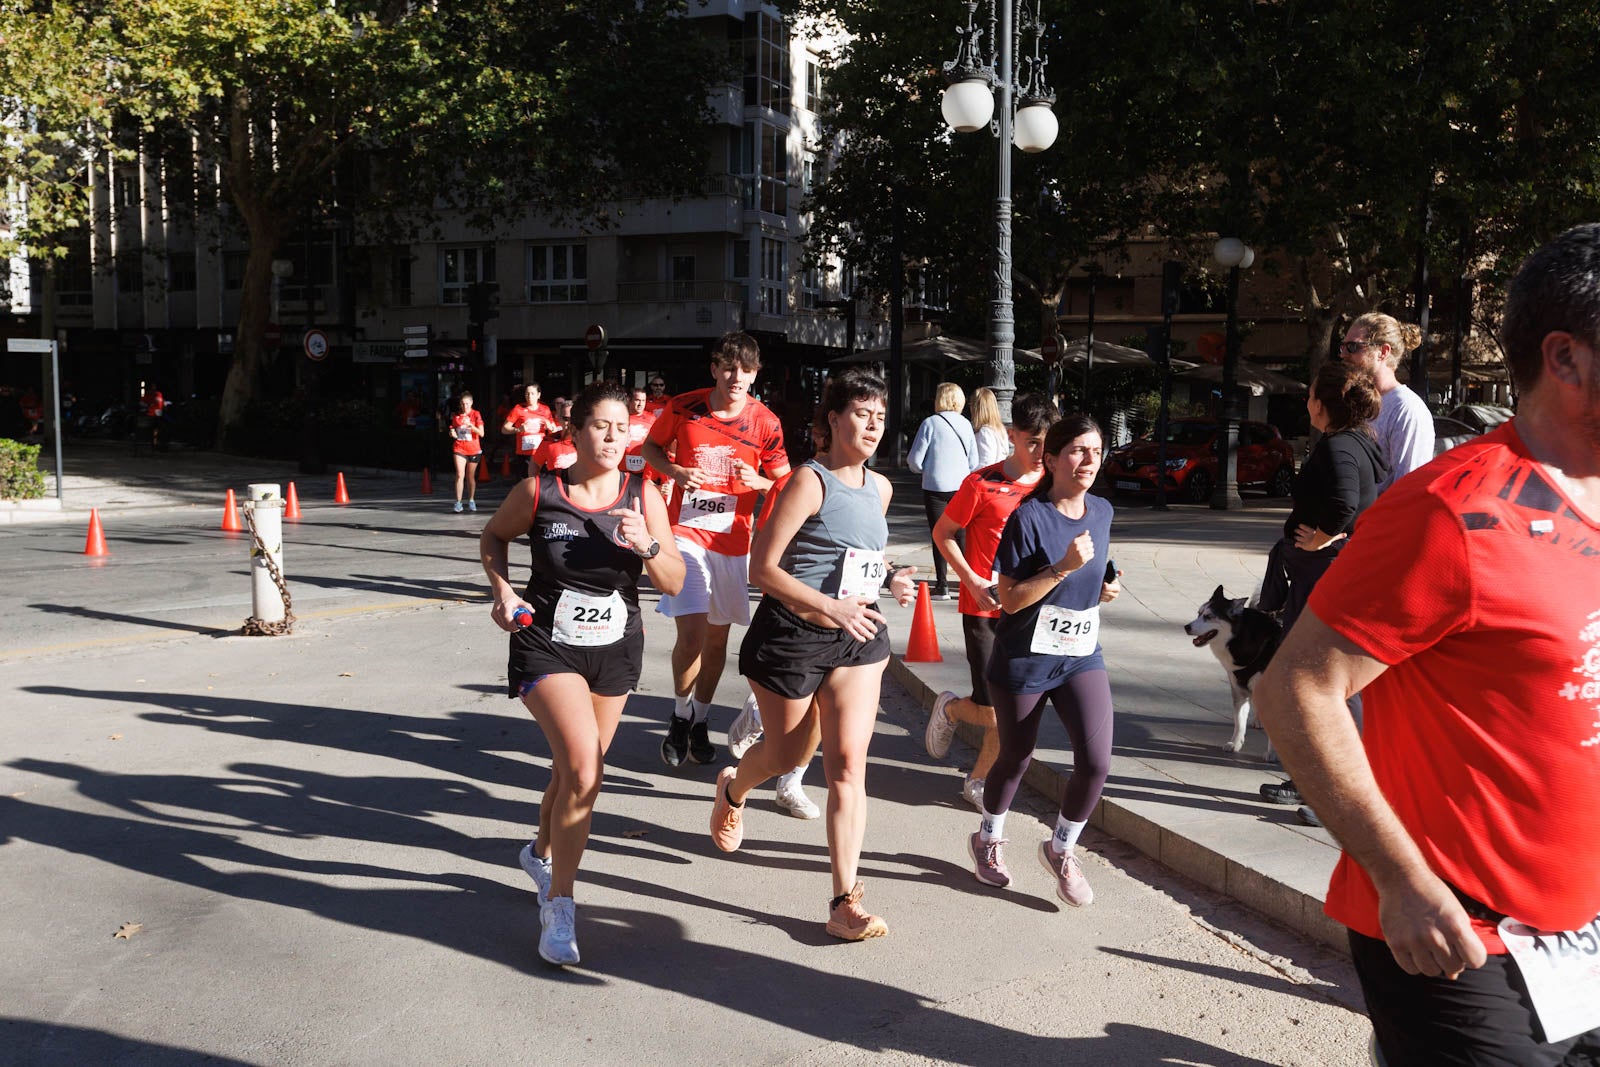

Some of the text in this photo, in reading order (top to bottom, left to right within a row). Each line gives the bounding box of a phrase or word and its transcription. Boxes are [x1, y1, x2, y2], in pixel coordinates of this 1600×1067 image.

[691, 497, 726, 514] 1296
[544, 533, 574, 541] CENTER
[572, 606, 612, 623] 224
[1049, 617, 1092, 635] 1219
